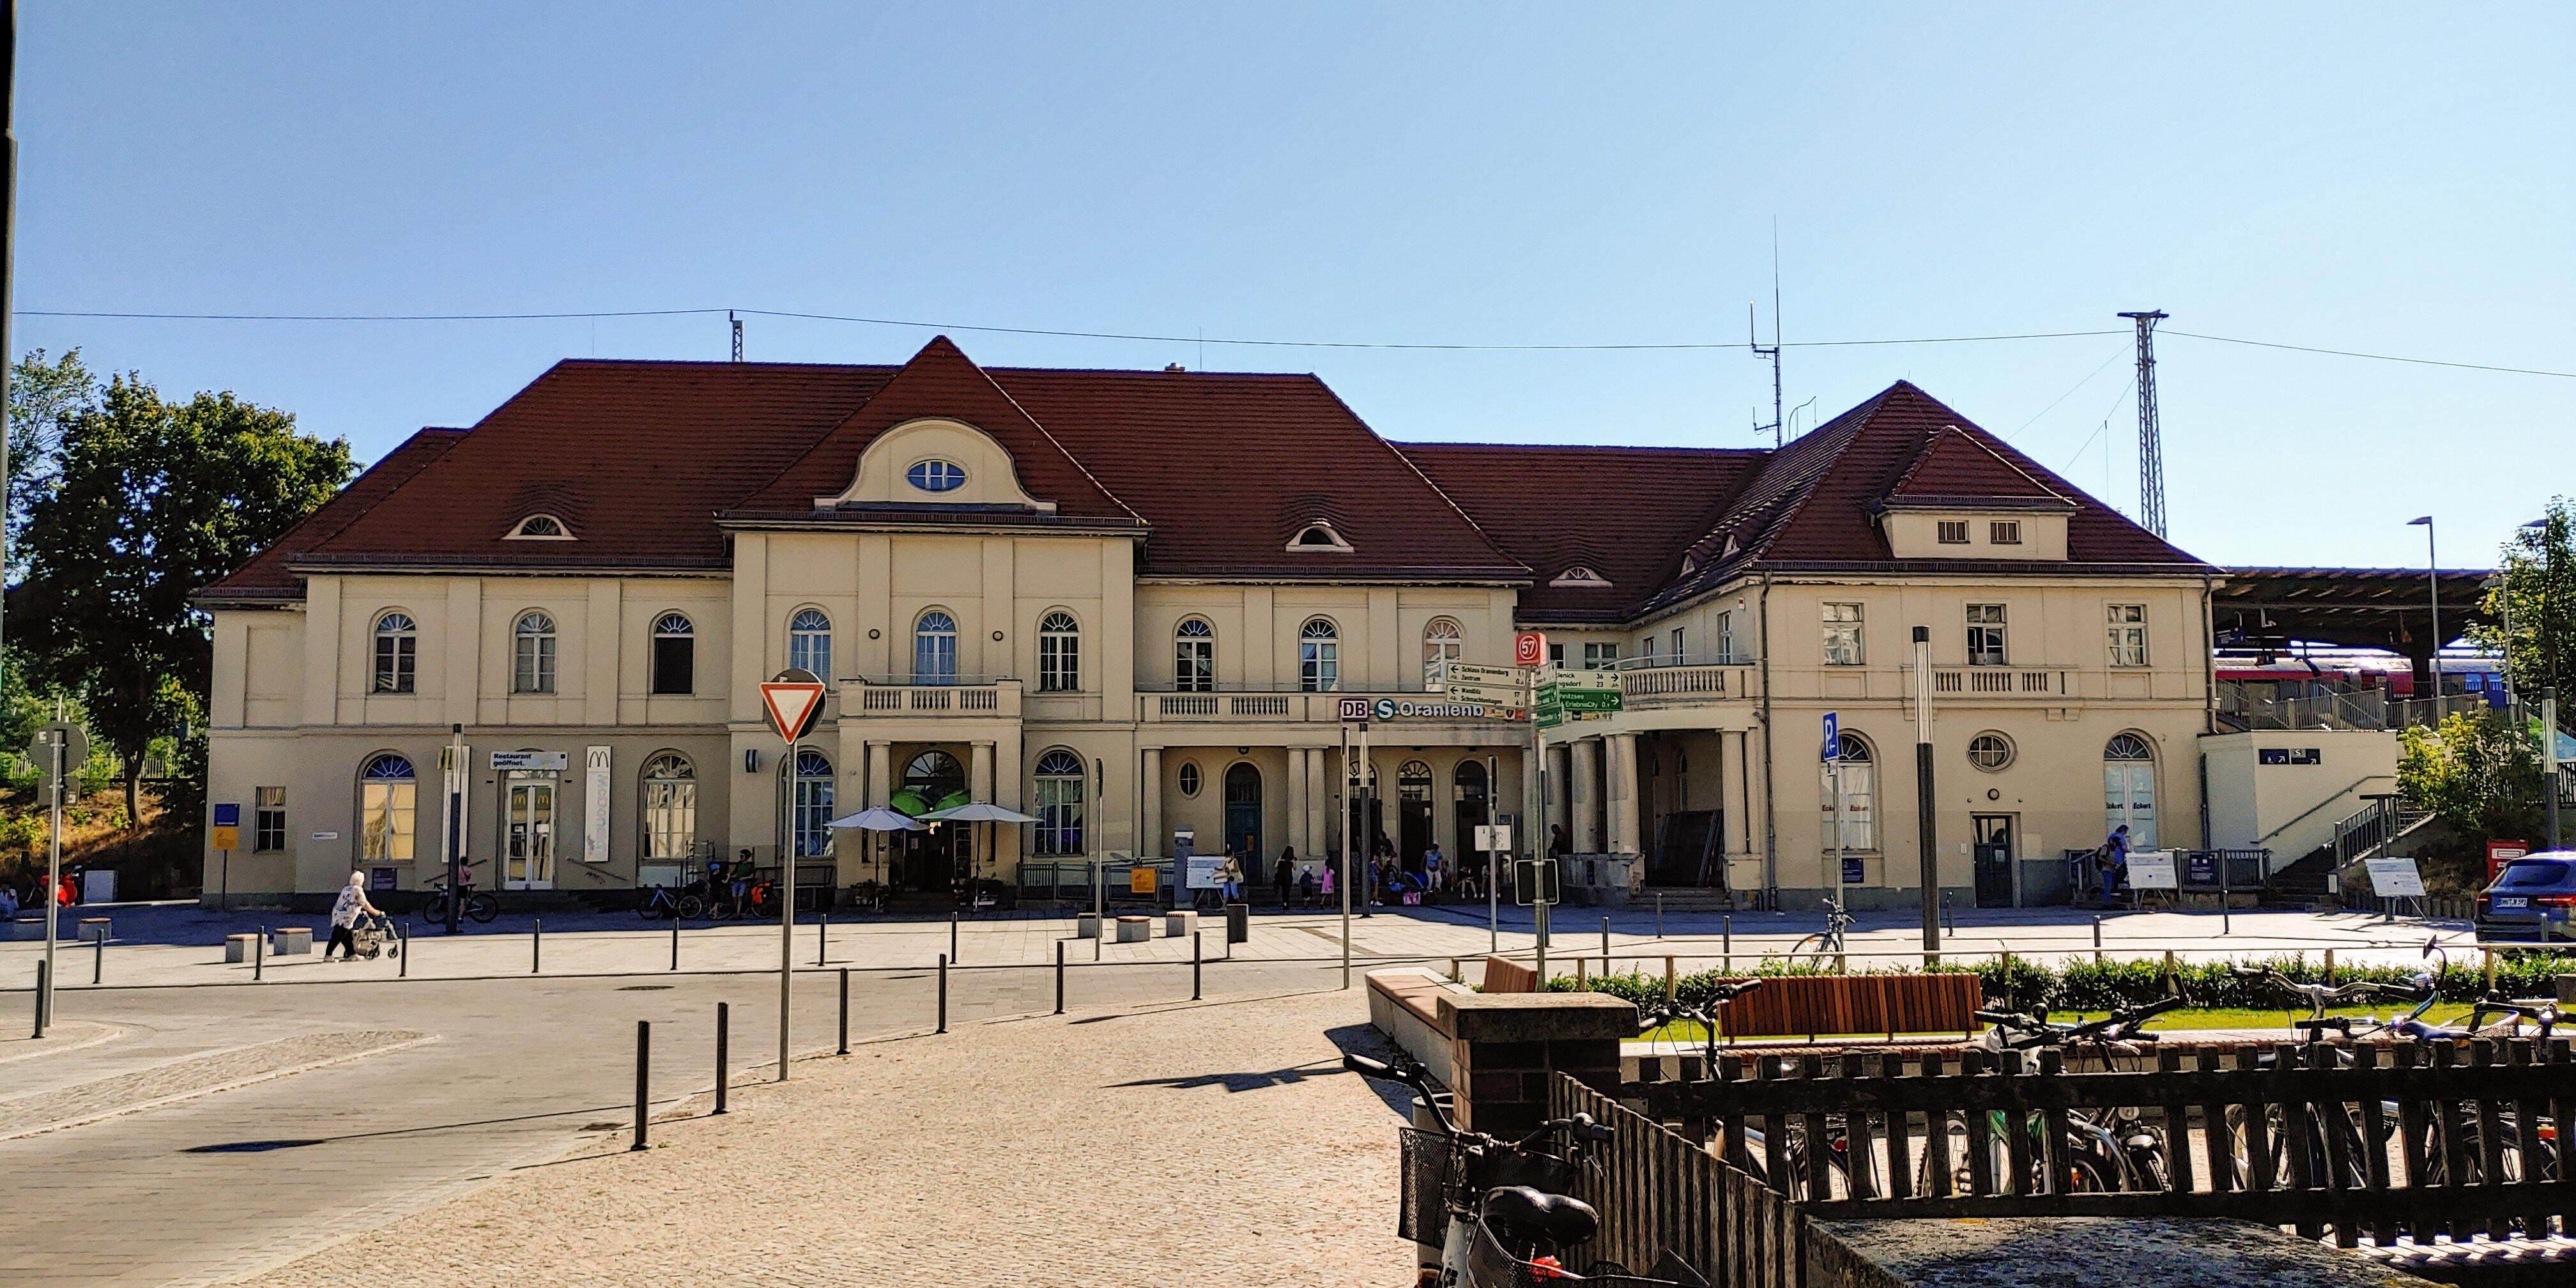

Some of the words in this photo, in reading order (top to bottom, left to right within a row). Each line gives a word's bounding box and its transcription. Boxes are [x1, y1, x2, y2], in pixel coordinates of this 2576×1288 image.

[1522, 641, 1535, 655] 57
[1343, 703, 1366, 716] DB
[1377, 700, 1393, 719] S
[1399, 702, 1485, 717] Oranienb
[1825, 719, 1832, 753] P
